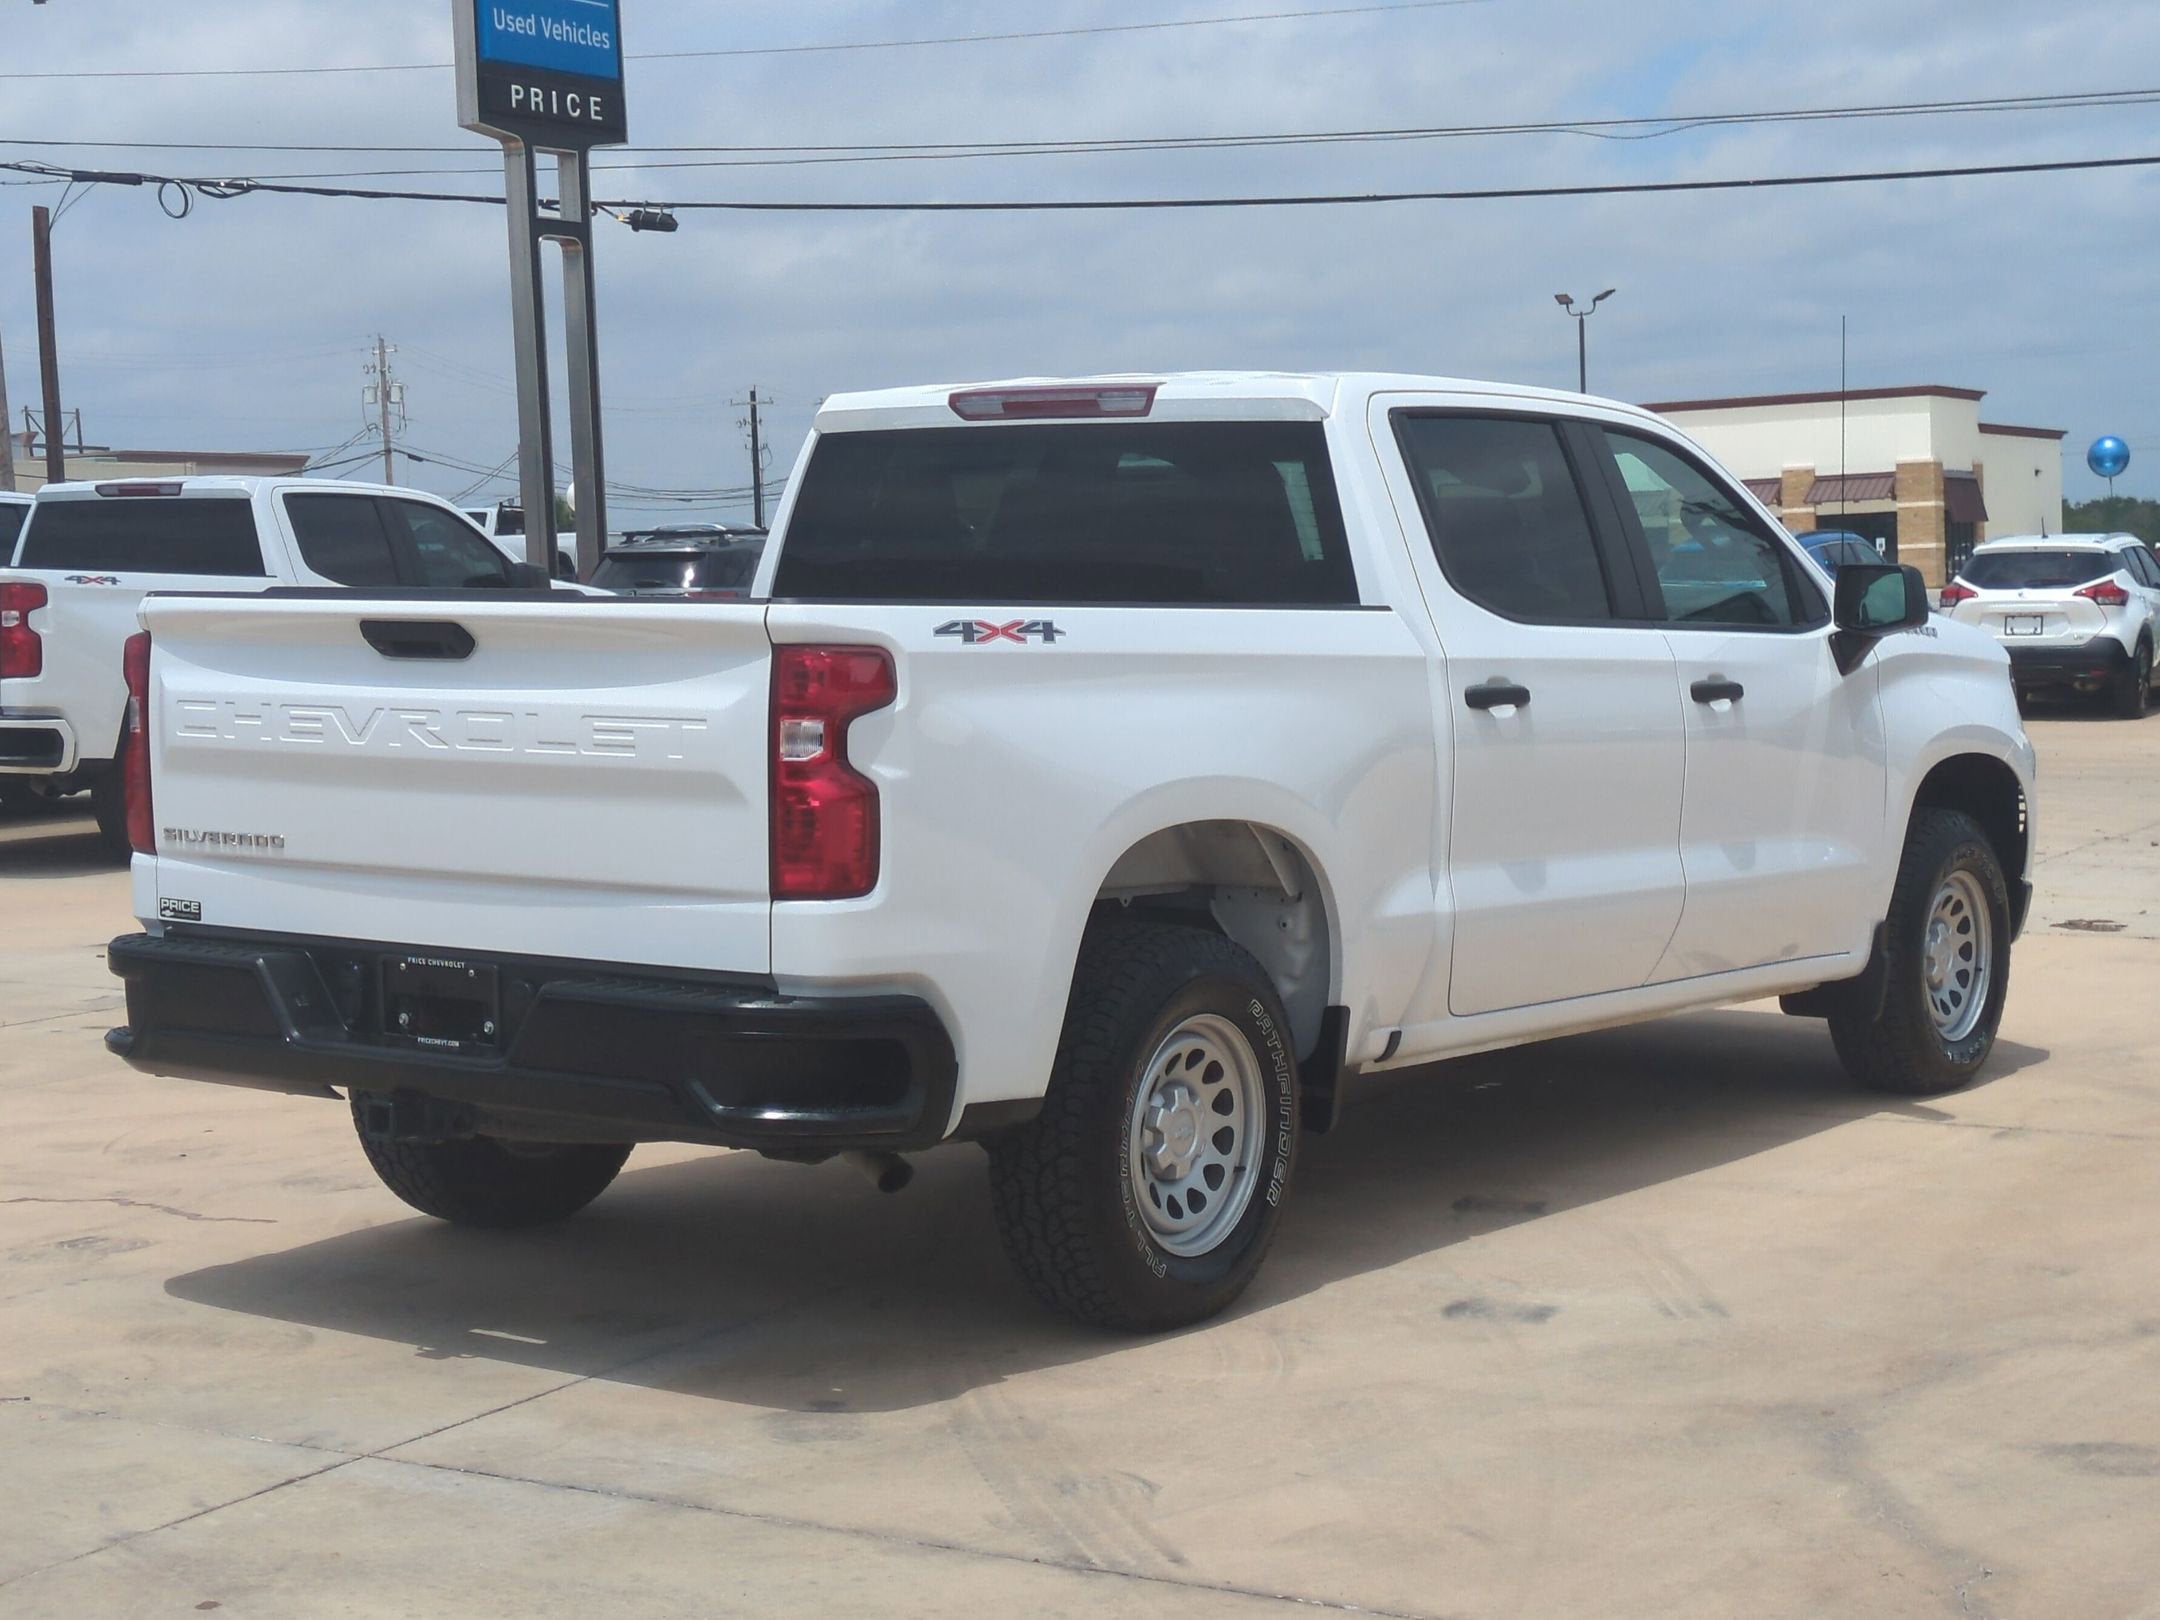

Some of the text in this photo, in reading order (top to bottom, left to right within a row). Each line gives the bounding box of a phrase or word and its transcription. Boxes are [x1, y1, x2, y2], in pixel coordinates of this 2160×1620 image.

[493, 8, 611, 49] Used Vehicles
[511, 84, 603, 121] PRICE
[176, 699, 708, 759] CHEVROLET
[163, 827, 285, 849] SILVERADO
[160, 898, 200, 914] PRICE
[407, 956, 465, 969] PRICE CHEVROLET
[1249, 999, 1292, 1207] PATHFINDER
[1136, 1230, 1167, 1278] ALL
